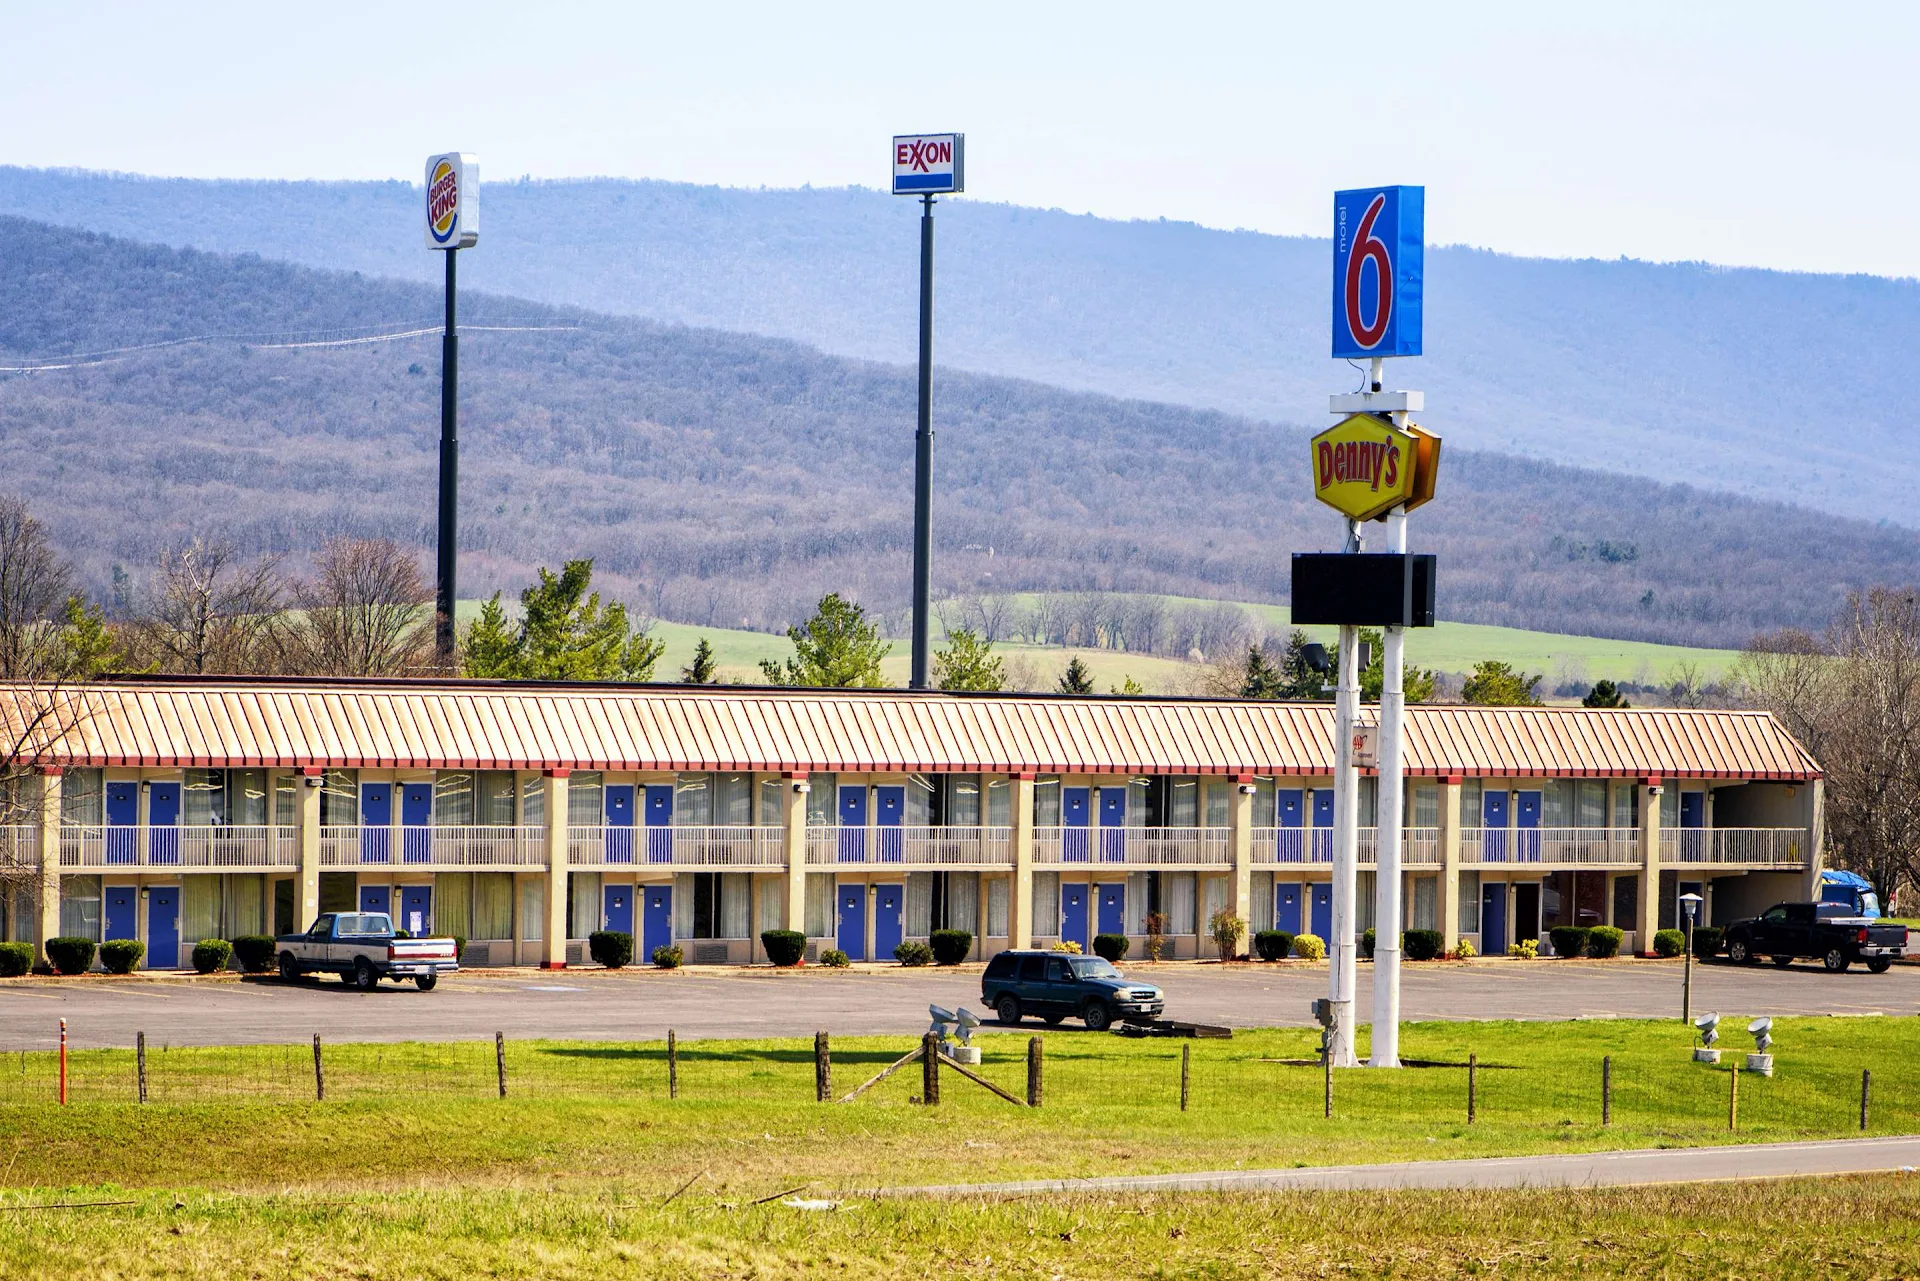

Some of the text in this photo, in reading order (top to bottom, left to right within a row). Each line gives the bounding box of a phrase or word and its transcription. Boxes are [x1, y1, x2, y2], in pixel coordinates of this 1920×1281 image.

[897, 139, 951, 173] EXXON
[430, 171, 456, 205] BURGER
[431, 186, 457, 228] KING
[1339, 206, 1347, 252] motel
[1345, 192, 1393, 350] 6
[1318, 434, 1400, 493] Denny's
